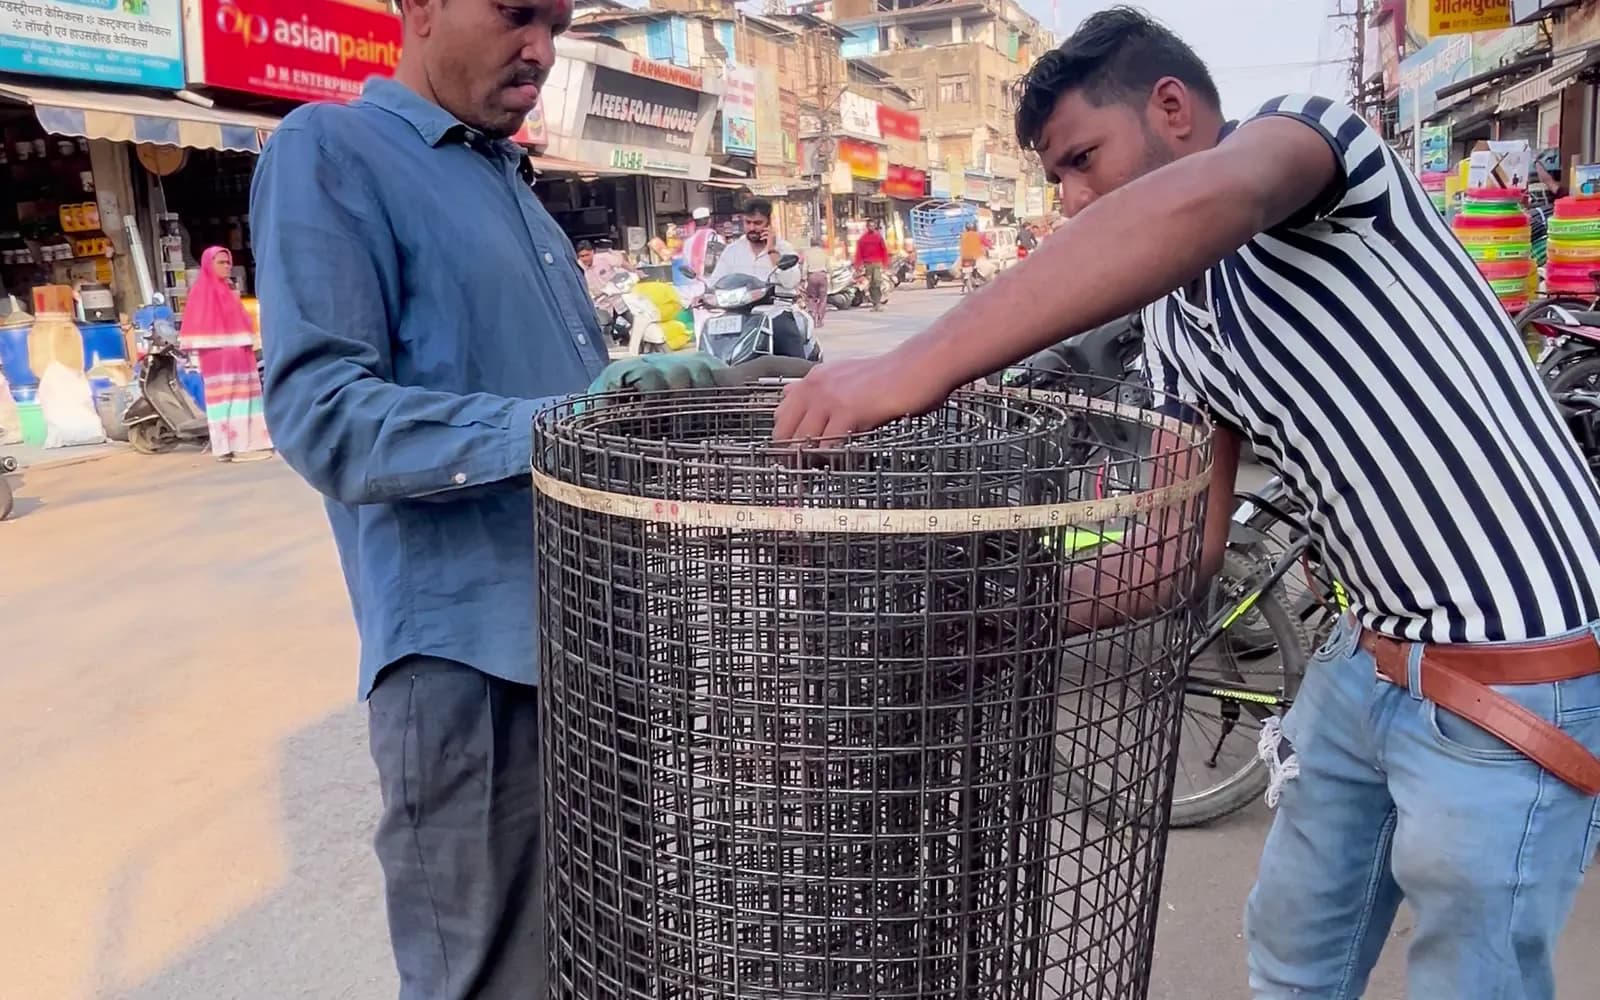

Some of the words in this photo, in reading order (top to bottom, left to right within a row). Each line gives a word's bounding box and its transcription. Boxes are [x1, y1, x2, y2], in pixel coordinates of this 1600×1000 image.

[628, 99, 664, 128] FOAM
[662, 107, 698, 133] HOUSE
[698, 510, 713, 520] 11
[736, 510, 755, 522] 10
[1050, 510, 1060, 520] 3
[1086, 506, 1094, 517] 2
[838, 515, 848, 526] 8
[882, 516, 891, 527] 7
[971, 514, 981, 526] 5
[1013, 512, 1022, 523] 4
